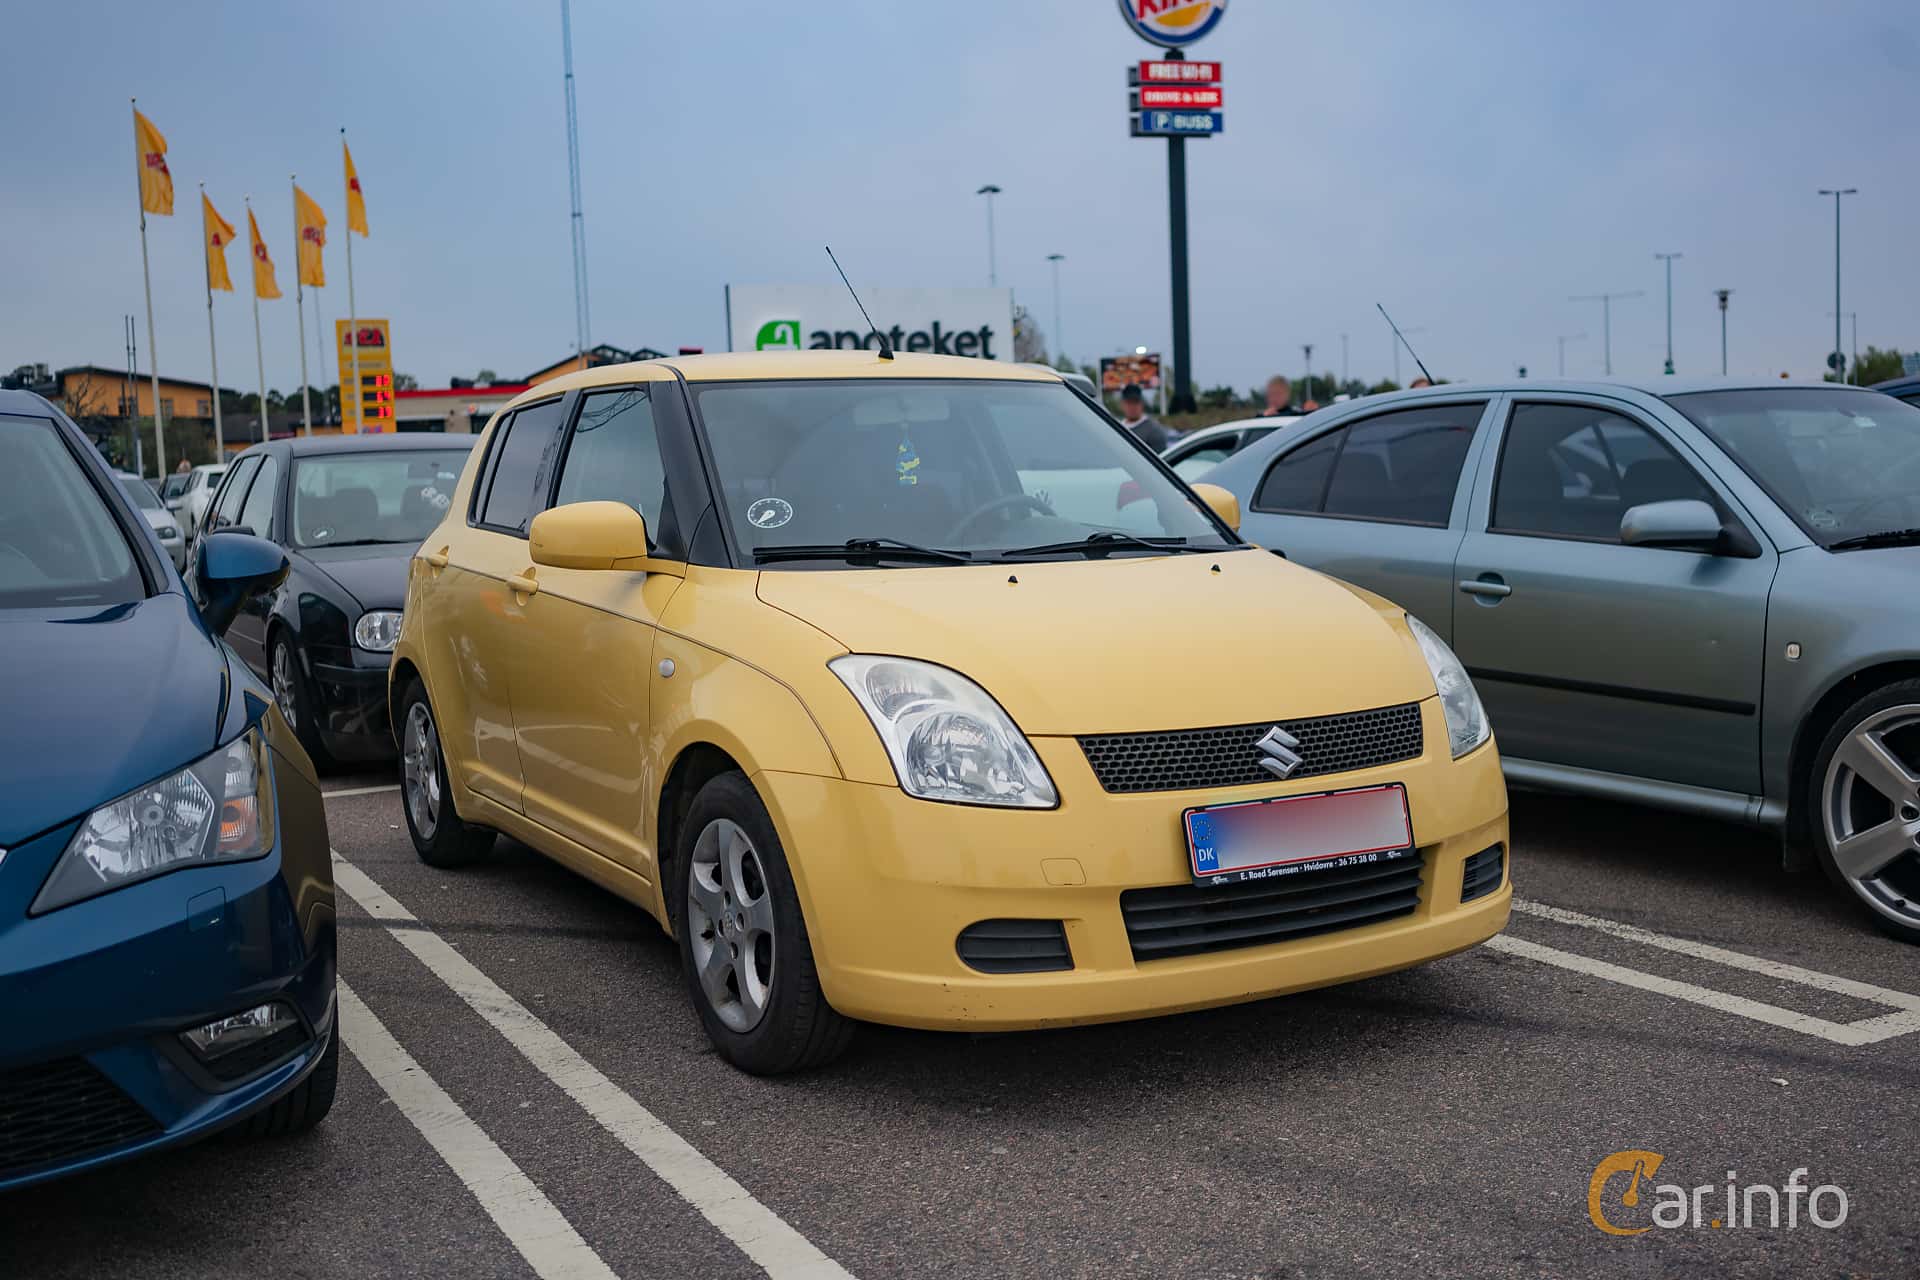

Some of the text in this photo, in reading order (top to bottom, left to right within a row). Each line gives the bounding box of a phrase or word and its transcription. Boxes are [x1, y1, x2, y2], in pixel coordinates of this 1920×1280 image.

[1149, 63, 1180, 80] FREE
[1173, 115, 1214, 130] BUSS
[808, 321, 997, 360] apoteket
[1199, 848, 1214, 862] DK
[1240, 872, 1248, 880] E.
[1303, 860, 1334, 872] Hvidovre
[1338, 858, 1348, 867] 36
[1348, 856, 1358, 866] 75
[1358, 855, 1367, 863] 38
[1368, 853, 1377, 862] 00
